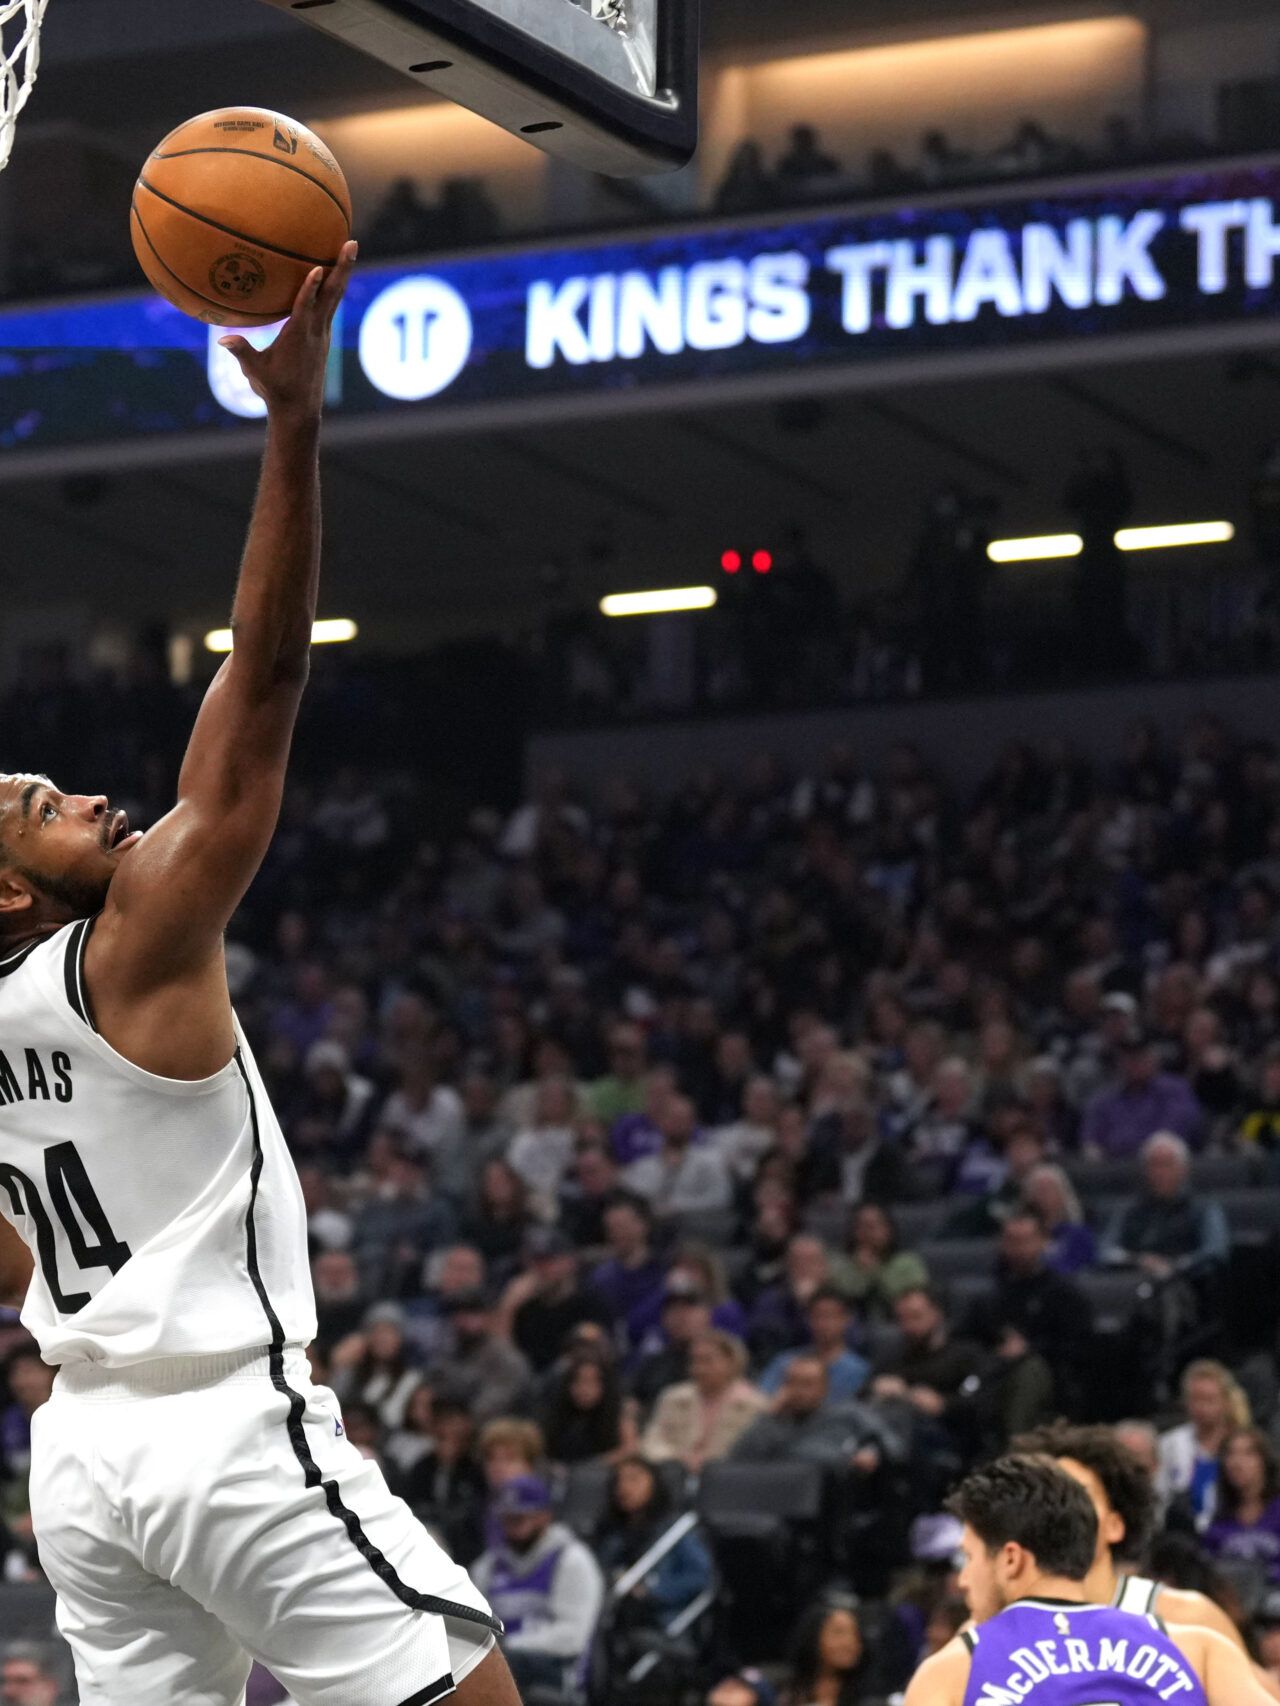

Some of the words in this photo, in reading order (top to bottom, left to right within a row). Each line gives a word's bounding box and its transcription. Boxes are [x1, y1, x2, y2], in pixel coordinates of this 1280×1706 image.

[525, 254, 809, 368] KINGS
[828, 209, 1165, 334] THANK
[974, 1637, 1194, 1706] McDERMOTT
